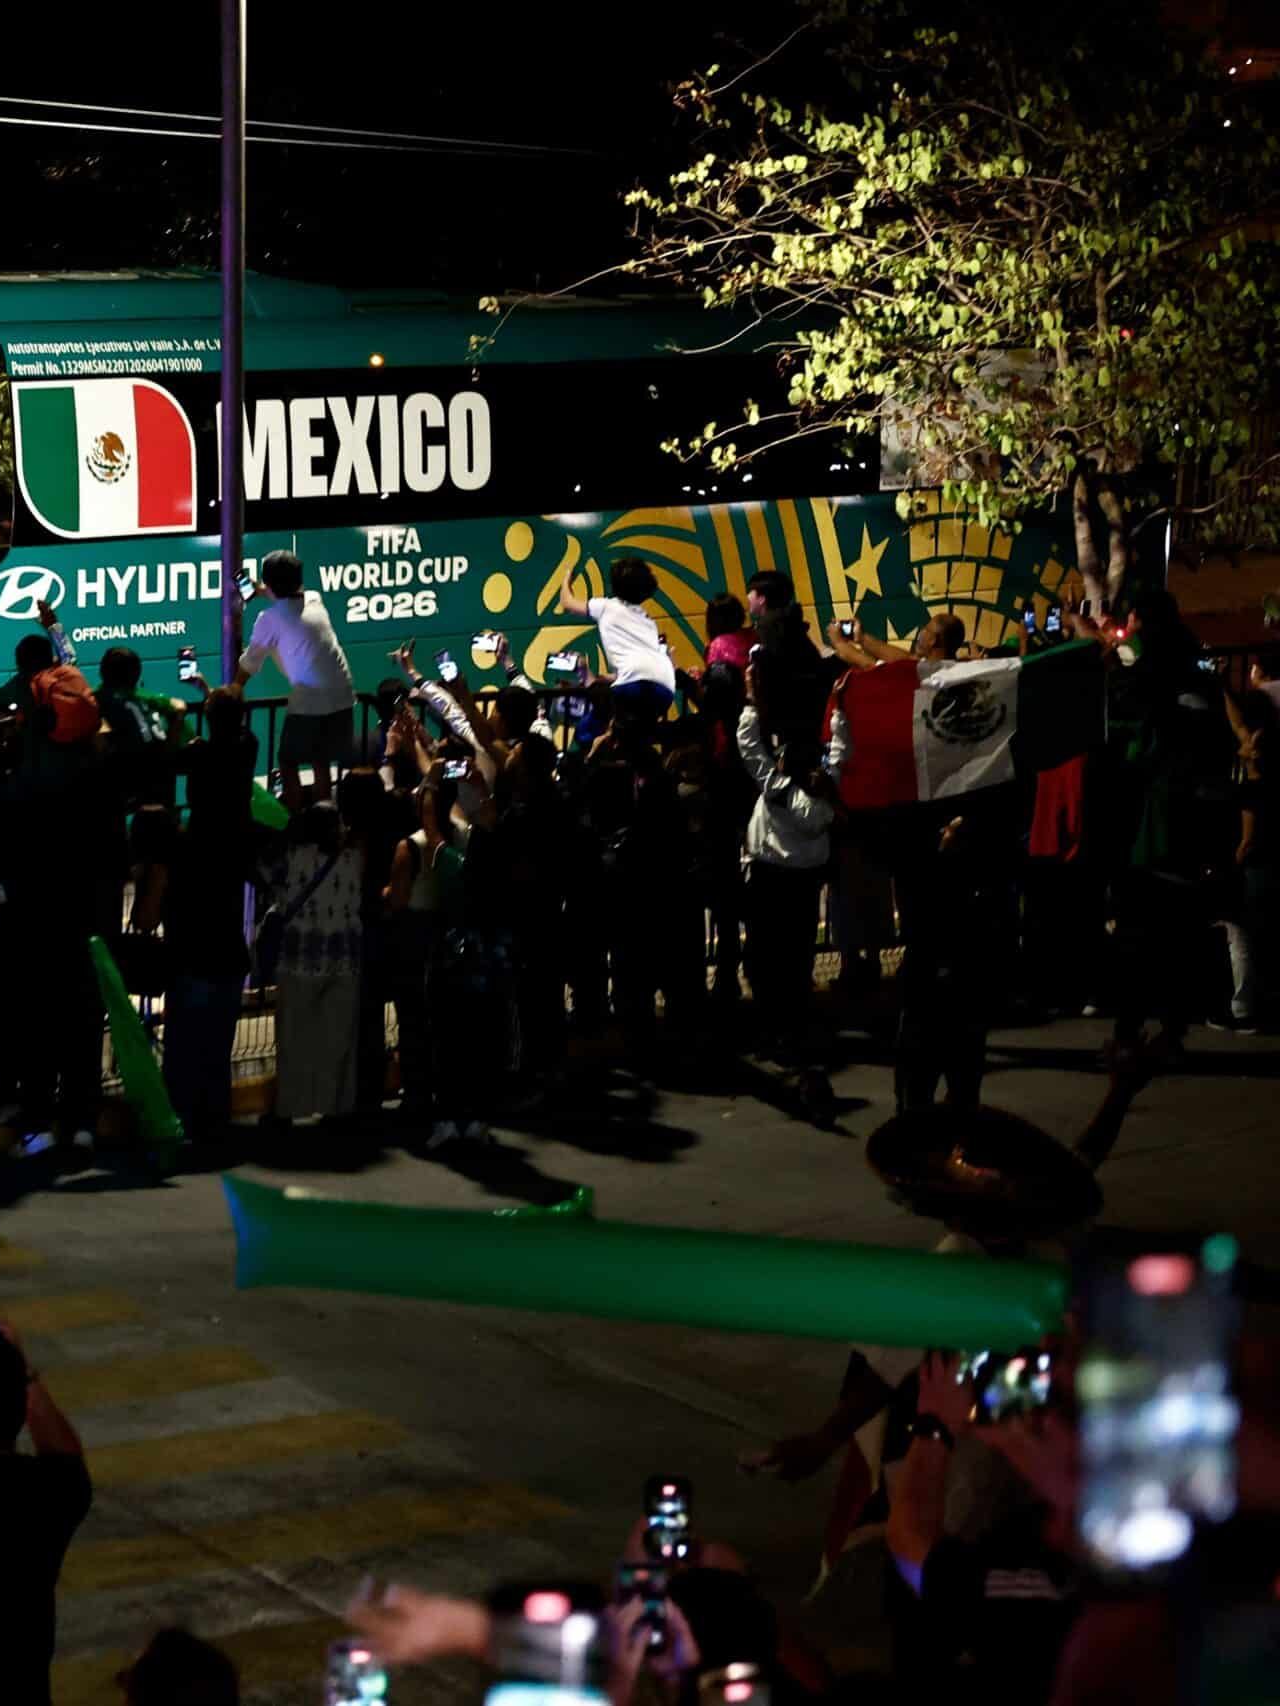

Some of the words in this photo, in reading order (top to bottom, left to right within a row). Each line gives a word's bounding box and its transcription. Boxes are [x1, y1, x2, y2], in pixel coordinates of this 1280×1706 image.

[7, 342, 84, 357] Autotransportes
[132, 340, 150, 352] Del
[150, 340, 173, 352] Valle
[193, 339, 206, 351] de
[11, 360, 45, 376] Permit
[216, 391, 491, 500] MEXICO
[367, 527, 421, 556] FIFA
[77, 557, 266, 608] HYUND
[319, 560, 413, 592] WORLD
[418, 556, 468, 584] CUP
[346, 590, 437, 623] 2026
[72, 624, 127, 642] OFFICIAL
[130, 621, 185, 637] PARTNER
